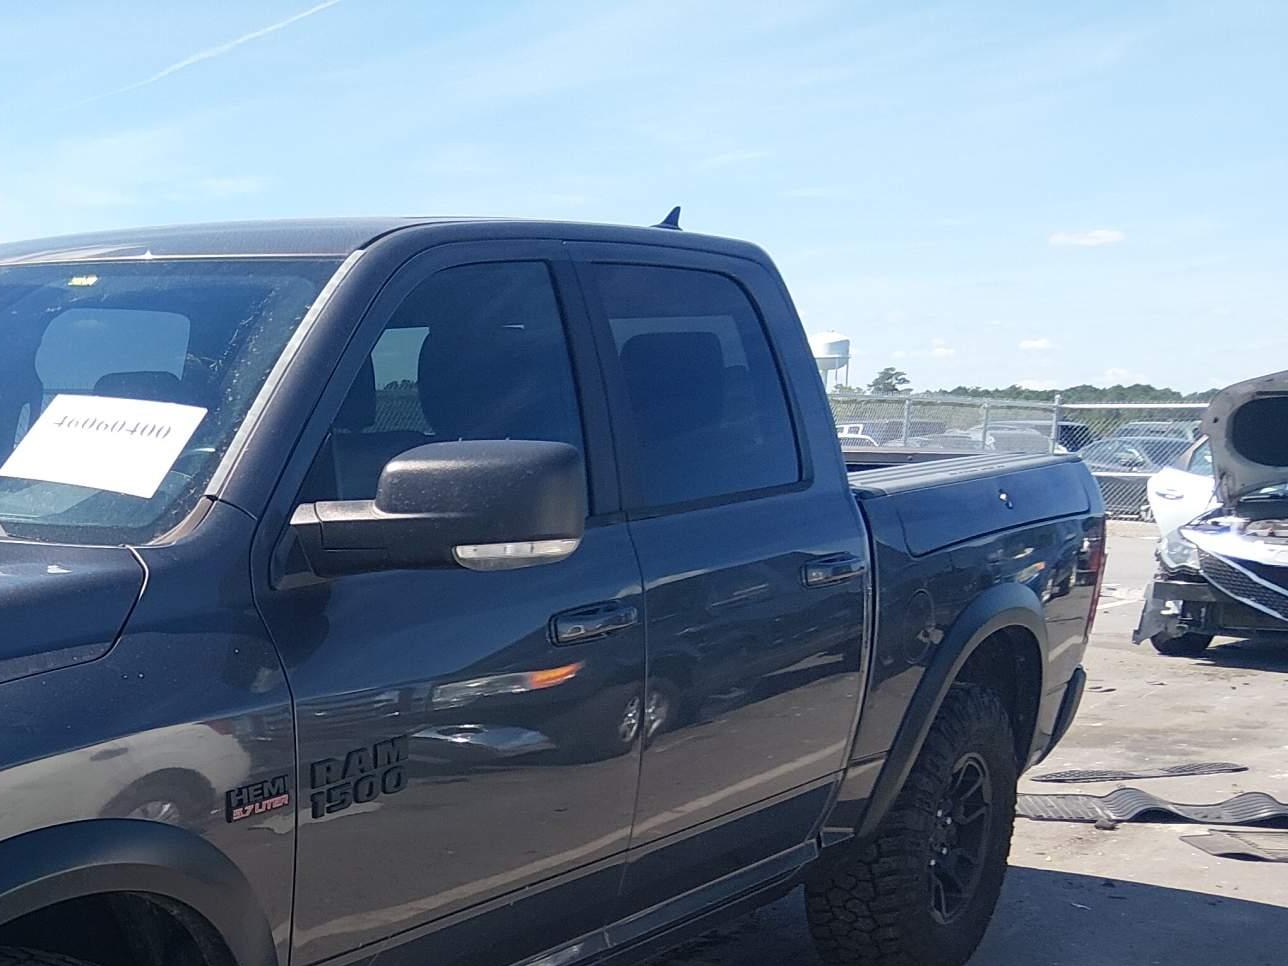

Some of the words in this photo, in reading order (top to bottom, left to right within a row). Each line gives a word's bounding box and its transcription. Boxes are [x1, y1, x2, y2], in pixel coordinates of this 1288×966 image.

[53, 415, 172, 439] 46060400
[312, 735, 409, 789] RAM
[229, 775, 289, 807] HEMI
[232, 804, 254, 820] 5.7
[254, 794, 289, 814] LITER
[311, 765, 409, 819] 1500
